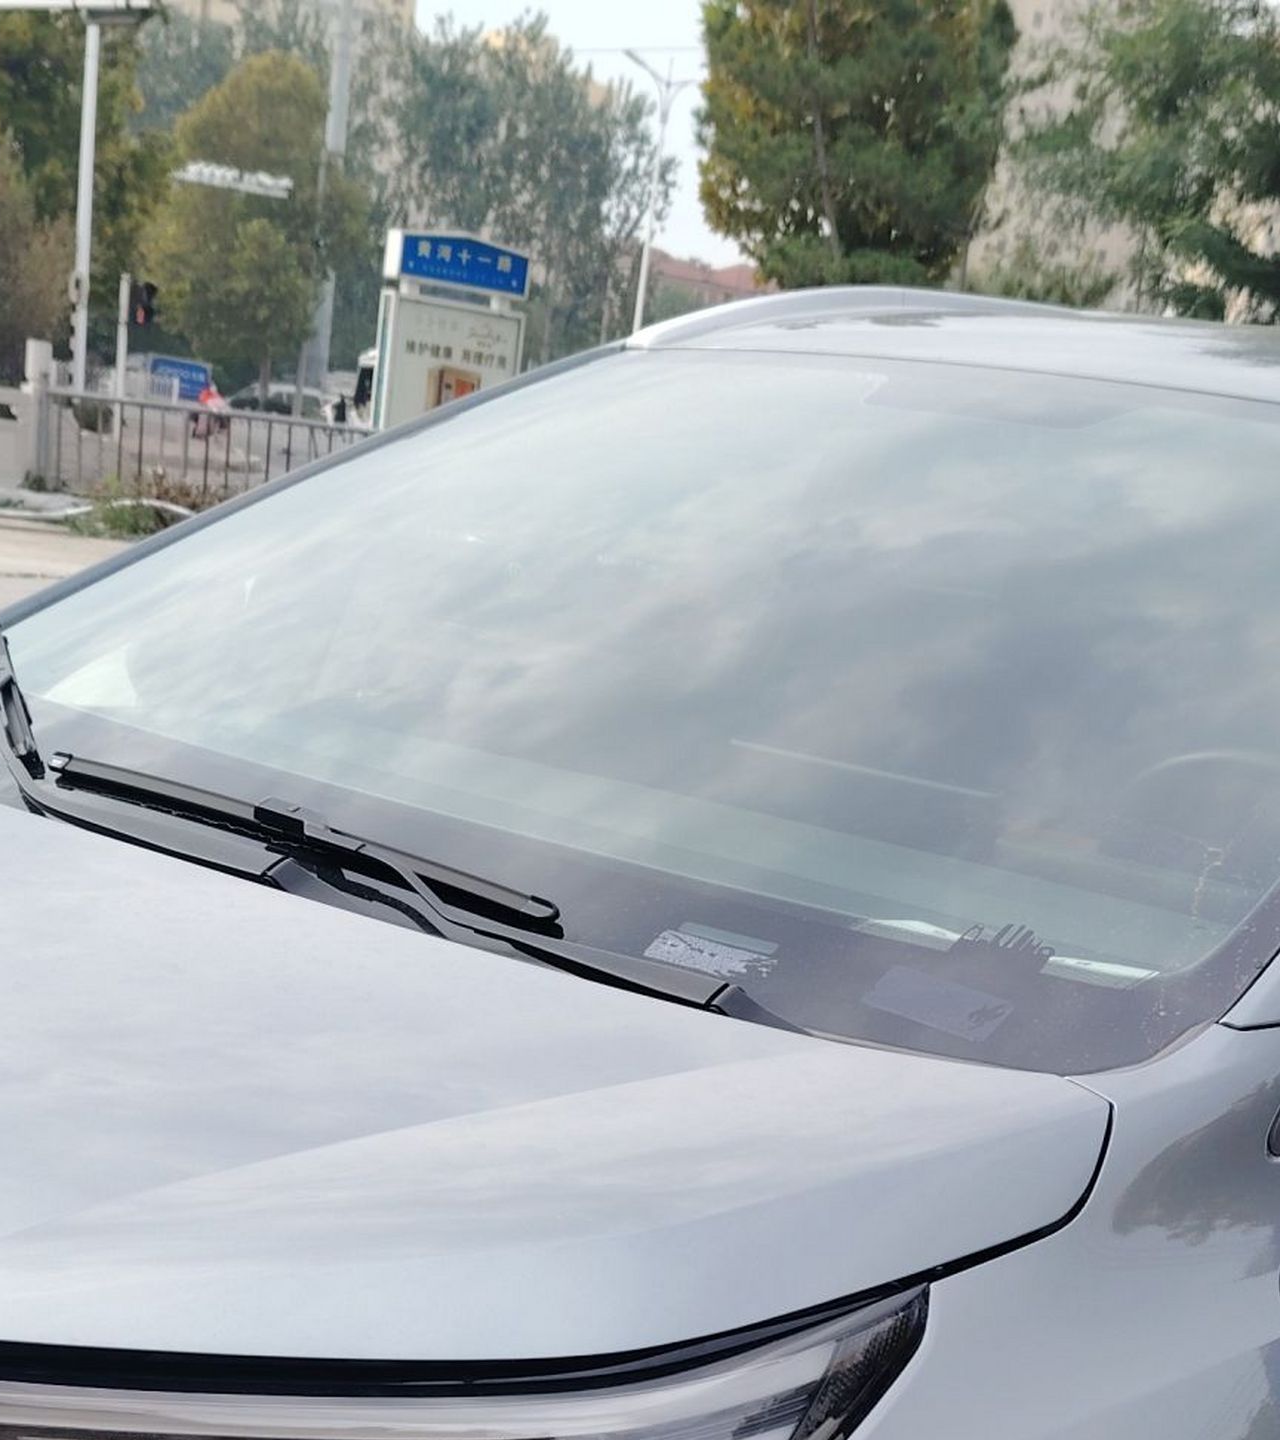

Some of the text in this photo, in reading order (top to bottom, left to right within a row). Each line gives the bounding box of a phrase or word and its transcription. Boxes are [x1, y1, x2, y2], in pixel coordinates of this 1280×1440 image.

[416, 239, 513, 273] 黄河十一路
